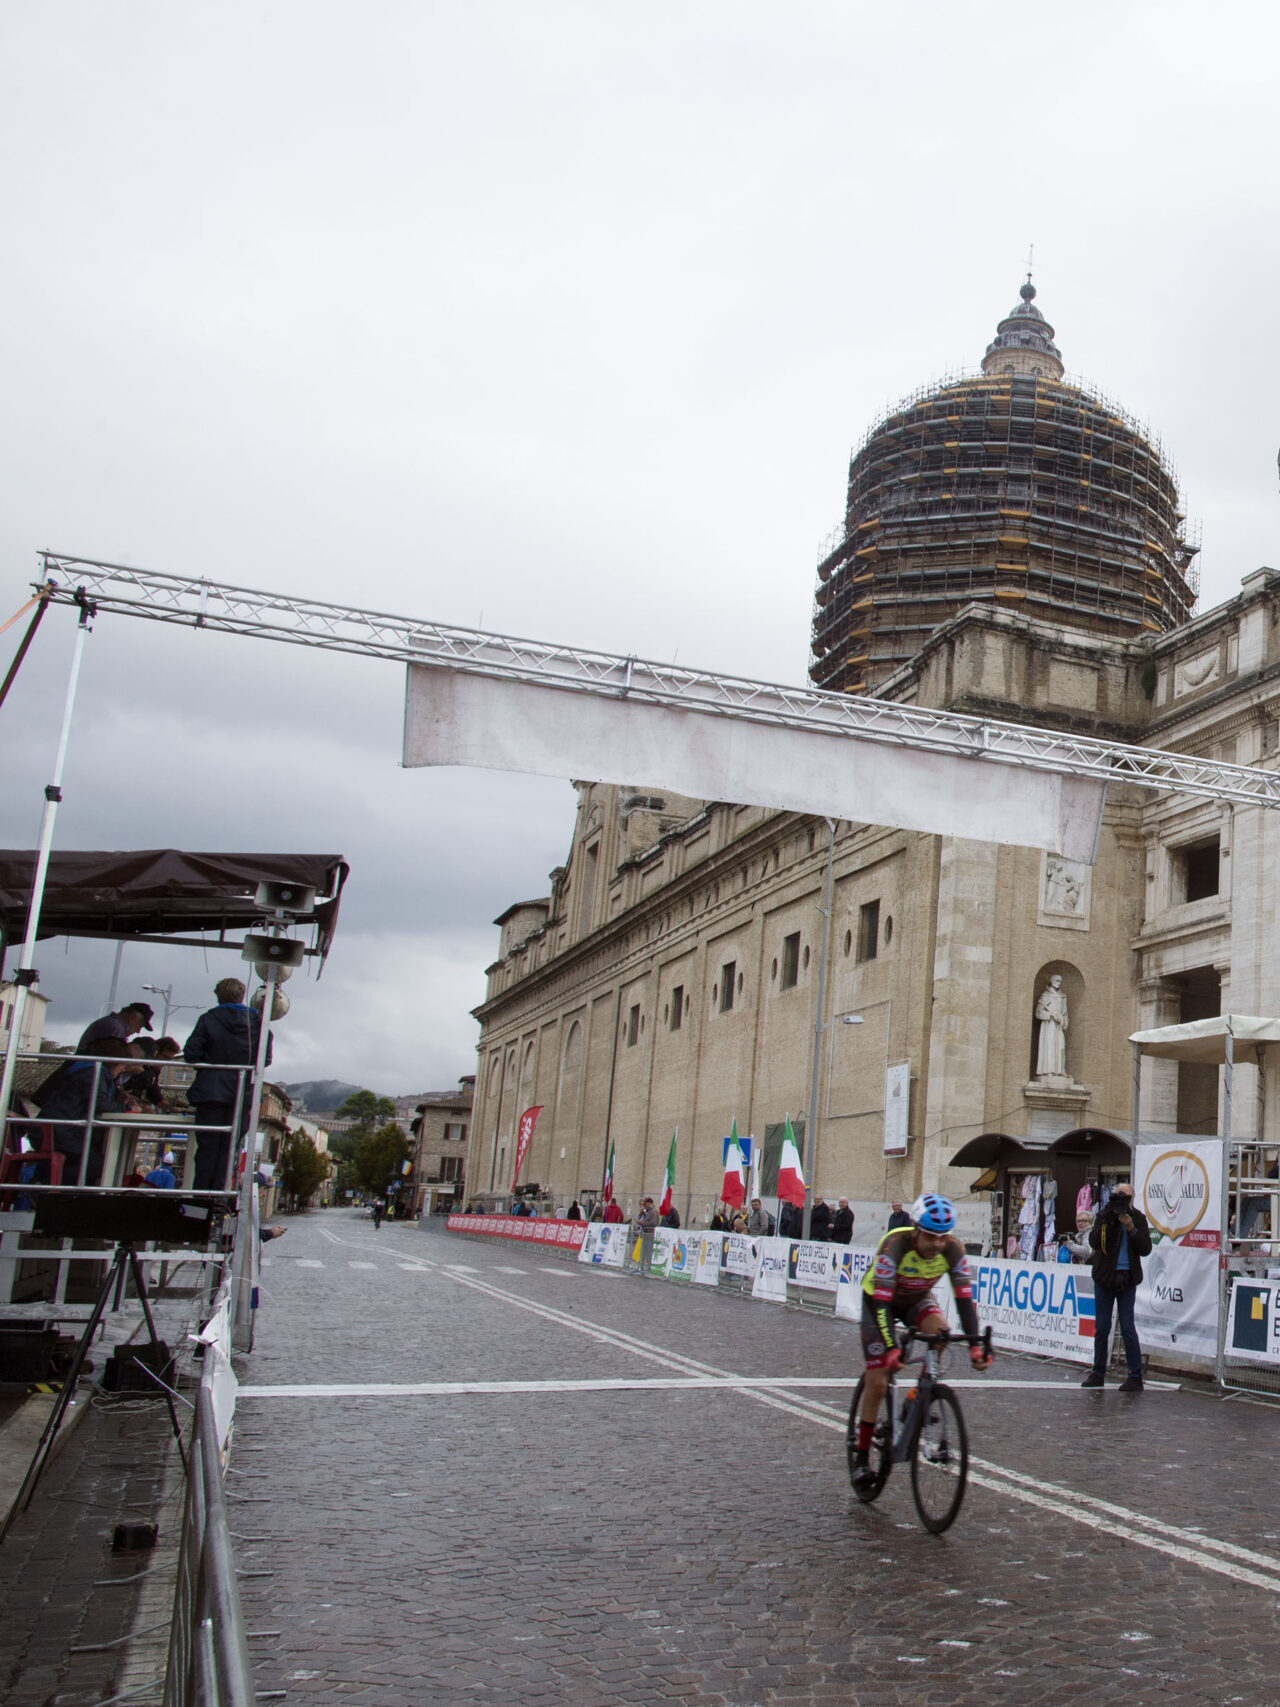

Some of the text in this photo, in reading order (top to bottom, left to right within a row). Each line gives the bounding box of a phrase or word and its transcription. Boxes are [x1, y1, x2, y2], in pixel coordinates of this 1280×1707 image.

[854, 1253, 875, 1272] REA
[977, 1266, 1077, 1317] FRAGOLA
[1155, 1285, 1184, 1303] MAB
[977, 1304, 1021, 1327] COSTRUZIONI
[1023, 1313, 1077, 1336] MECCANICHE
[1273, 1317, 1280, 1338] E
